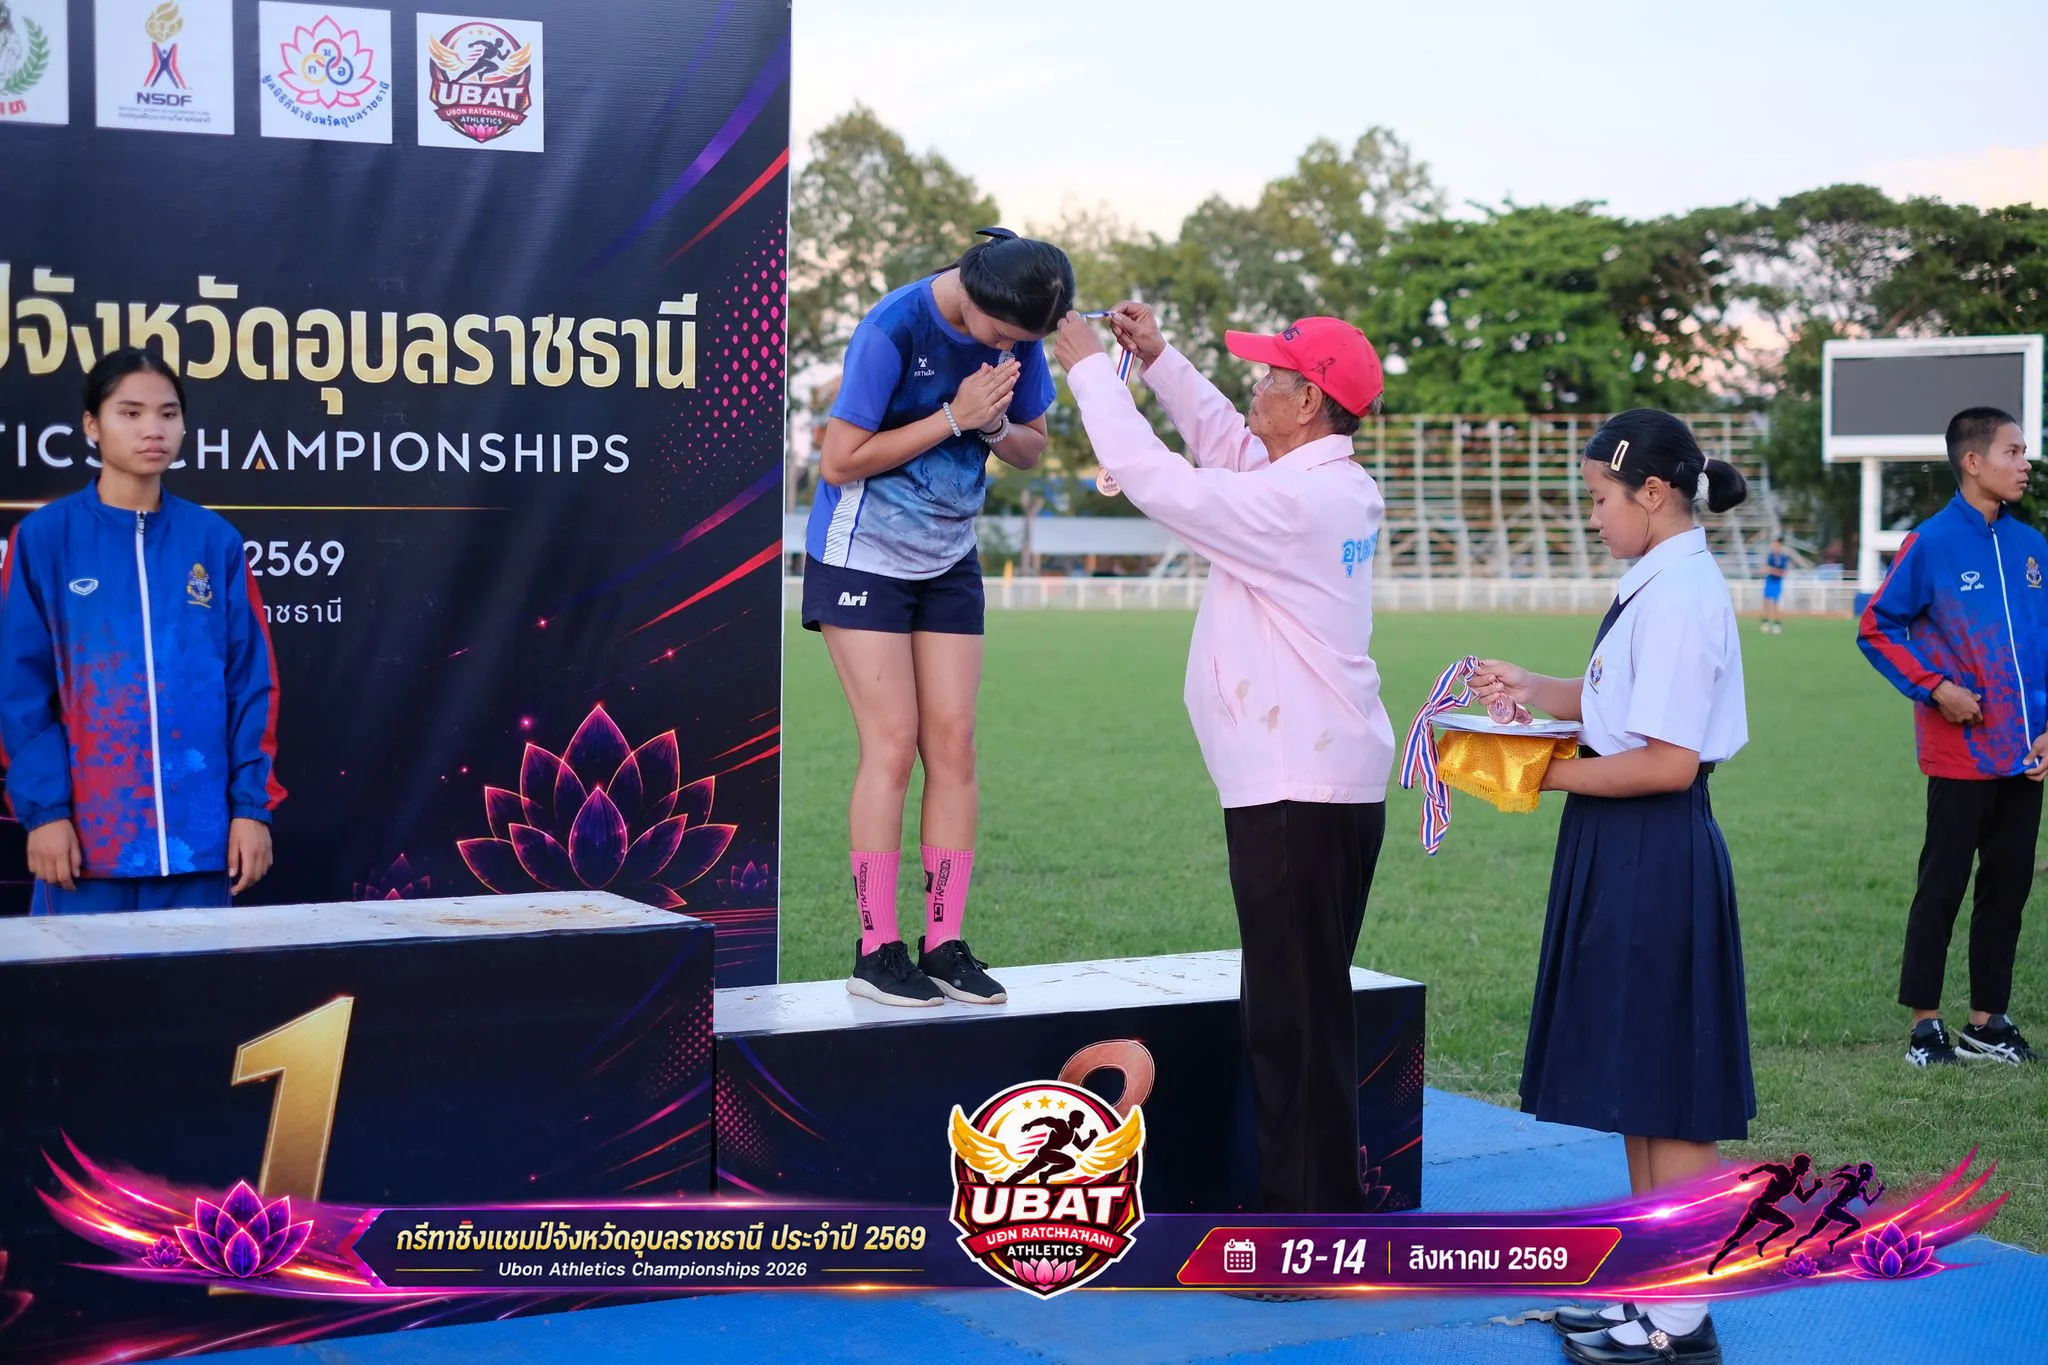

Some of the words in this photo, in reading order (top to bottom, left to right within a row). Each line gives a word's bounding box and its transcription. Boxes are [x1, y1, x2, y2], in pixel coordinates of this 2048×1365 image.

[136, 92, 193, 107] NSDF
[438, 82, 524, 109] UBAT
[460, 116, 503, 125] ATHLETICS
[468, 106, 519, 121] RATCHATHANI
[0, 424, 103, 468] IC
[168, 428, 631, 474] HAMPIONSHIPS
[243, 540, 346, 577] 2569
[838, 591, 868, 606] Ari
[208, 997, 354, 1295] 1
